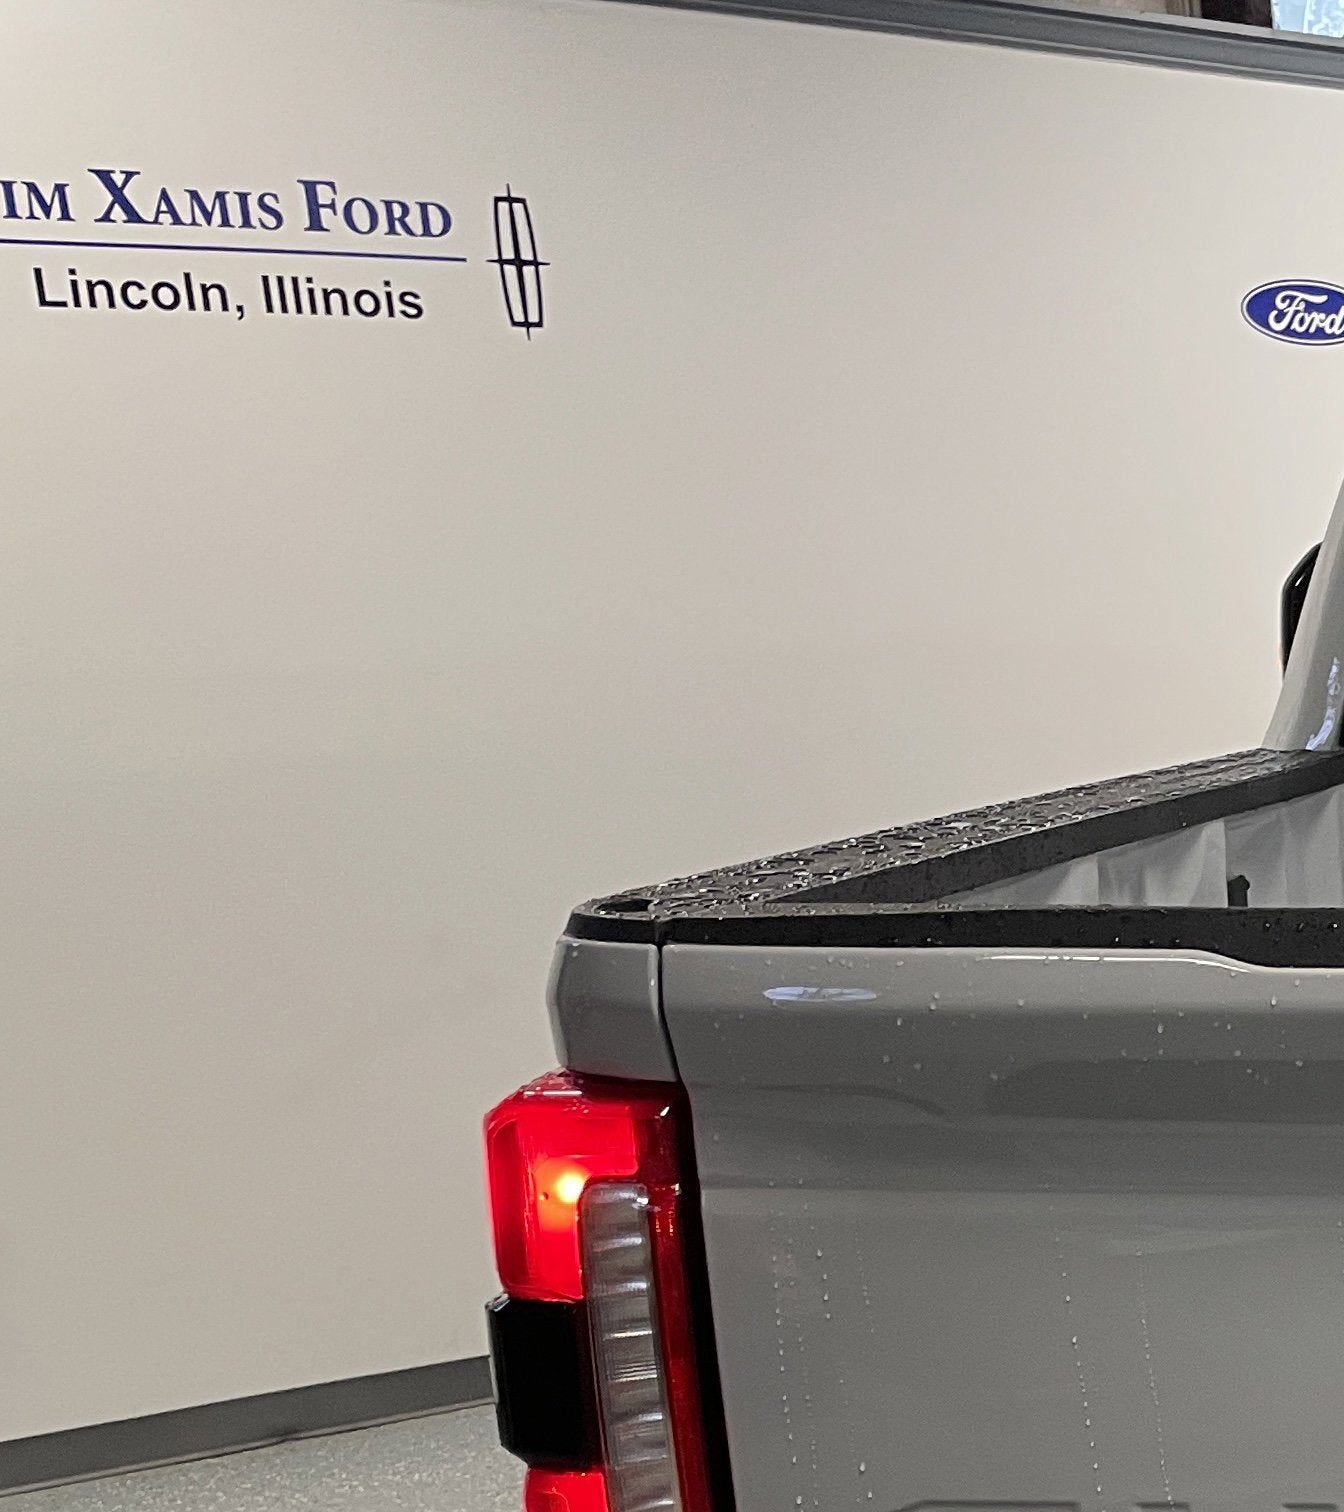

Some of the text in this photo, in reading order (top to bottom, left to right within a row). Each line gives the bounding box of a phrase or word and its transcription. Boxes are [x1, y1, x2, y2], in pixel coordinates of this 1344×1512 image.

[0, 178, 76, 222] IM
[32, 267, 425, 320] Lincoln, Illinois
